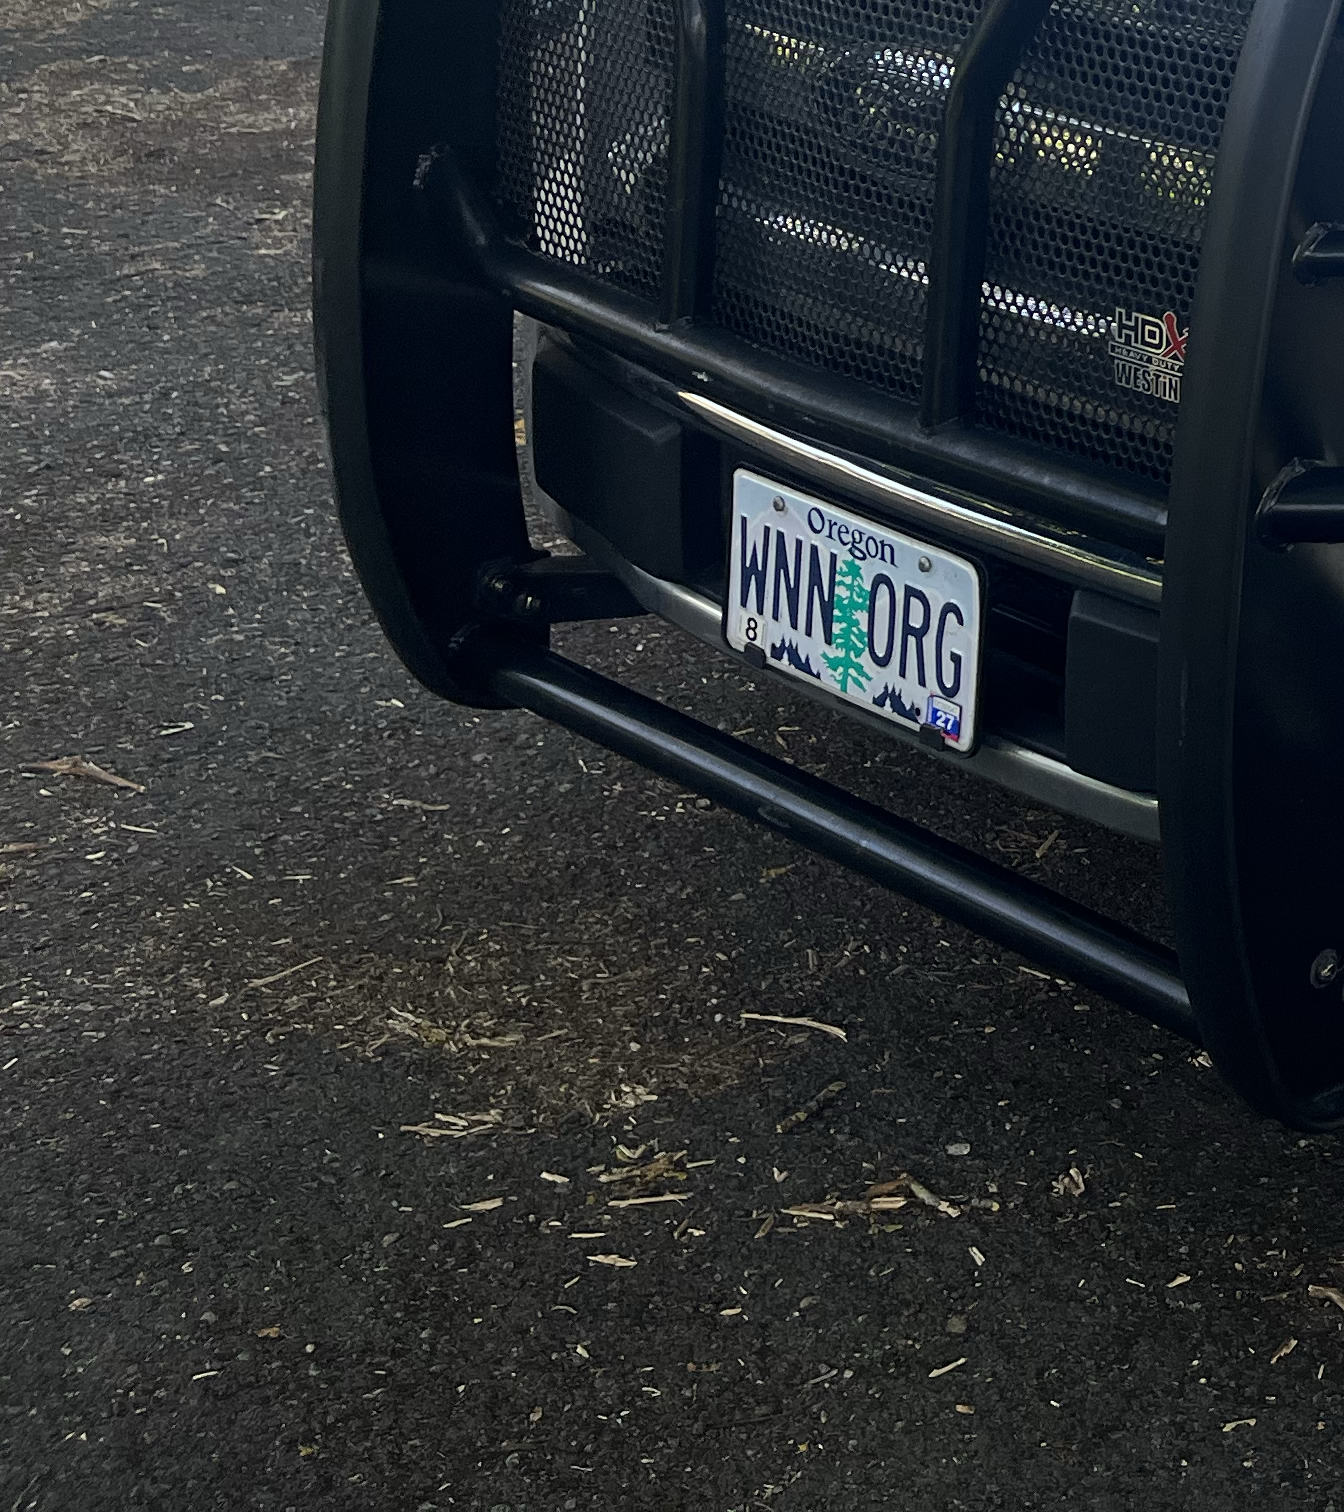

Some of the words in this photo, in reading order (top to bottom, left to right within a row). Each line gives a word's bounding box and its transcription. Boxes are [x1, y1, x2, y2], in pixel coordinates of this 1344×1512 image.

[1115, 307, 1189, 362] HDX
[1114, 346, 1149, 362] HEAVY
[1151, 356, 1180, 371] DUTY
[807, 506, 898, 568] Oregon
[740, 515, 838, 646] WNN
[868, 572, 964, 699] ORG
[745, 617, 758, 642] 8
[935, 710, 955, 731] 27
